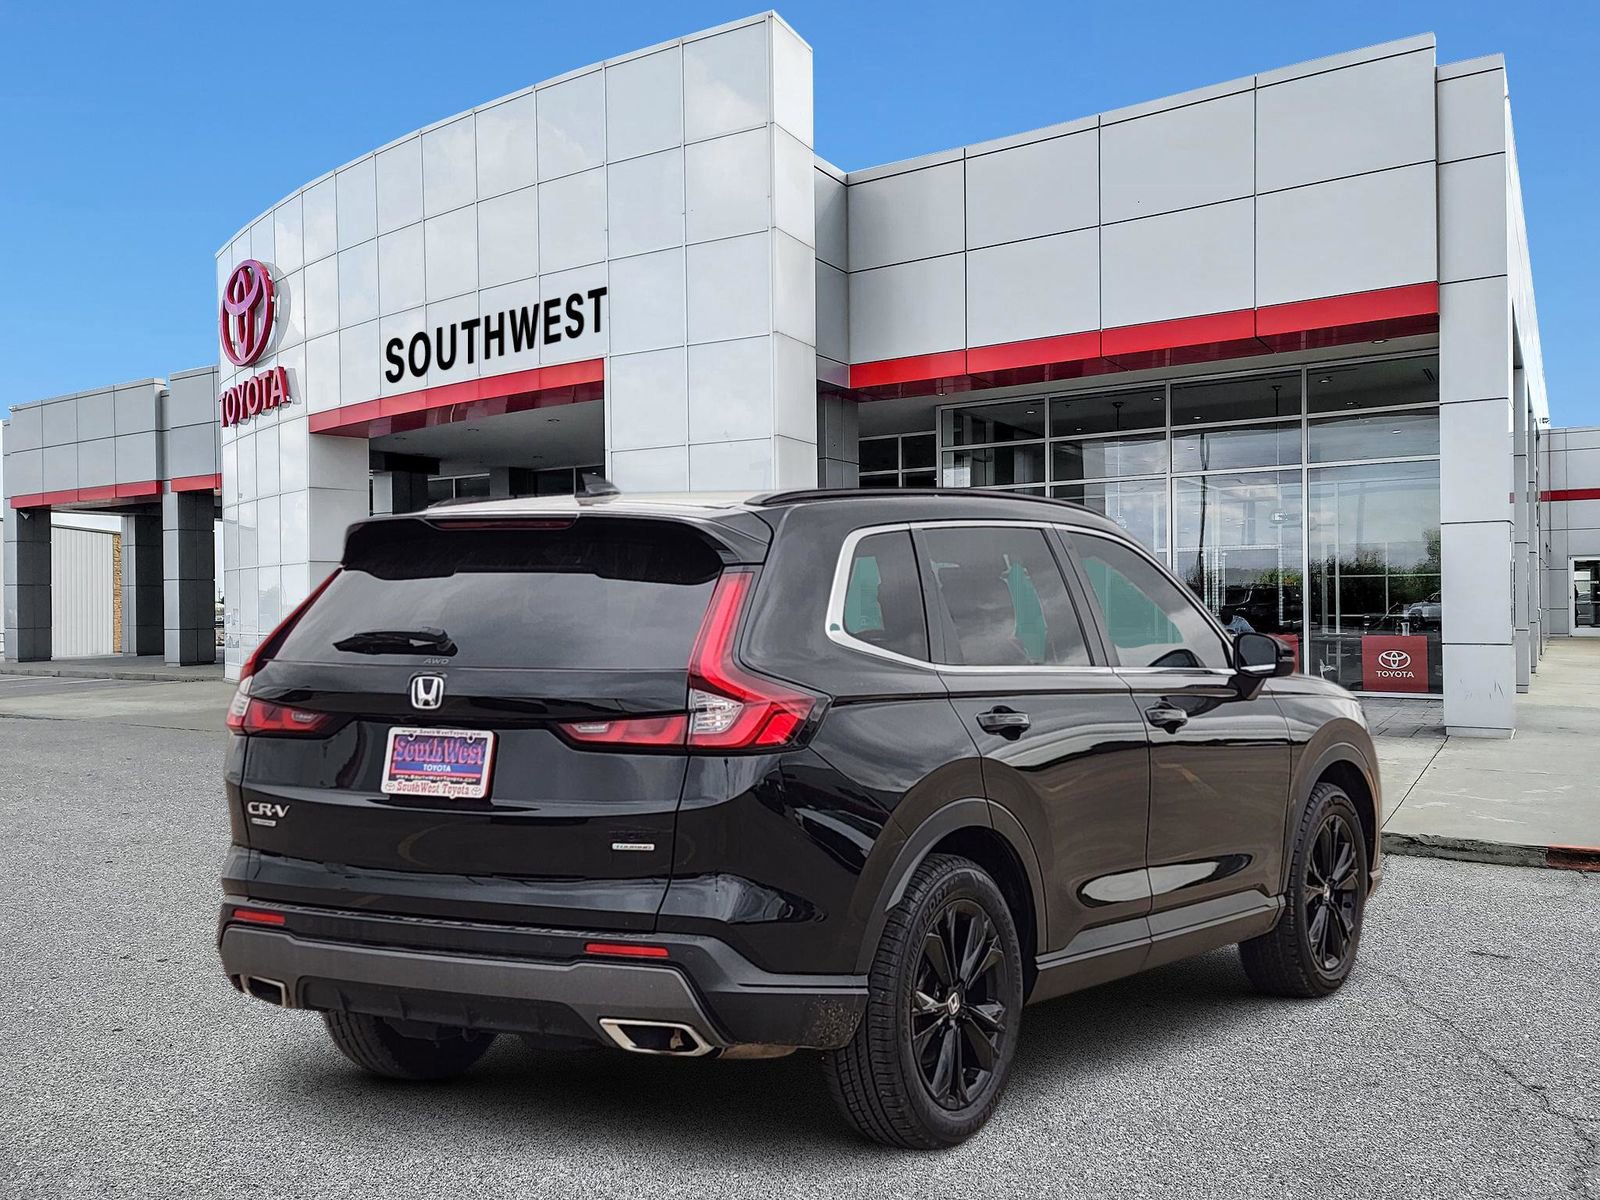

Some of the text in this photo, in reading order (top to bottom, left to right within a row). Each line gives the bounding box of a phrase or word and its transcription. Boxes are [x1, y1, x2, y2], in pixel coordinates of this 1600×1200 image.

[385, 287, 608, 384] SOUTHWEST
[219, 366, 290, 428] TOYOTA
[1376, 670, 1415, 678] TOYOTA
[423, 764, 452, 772] TOYOTA
